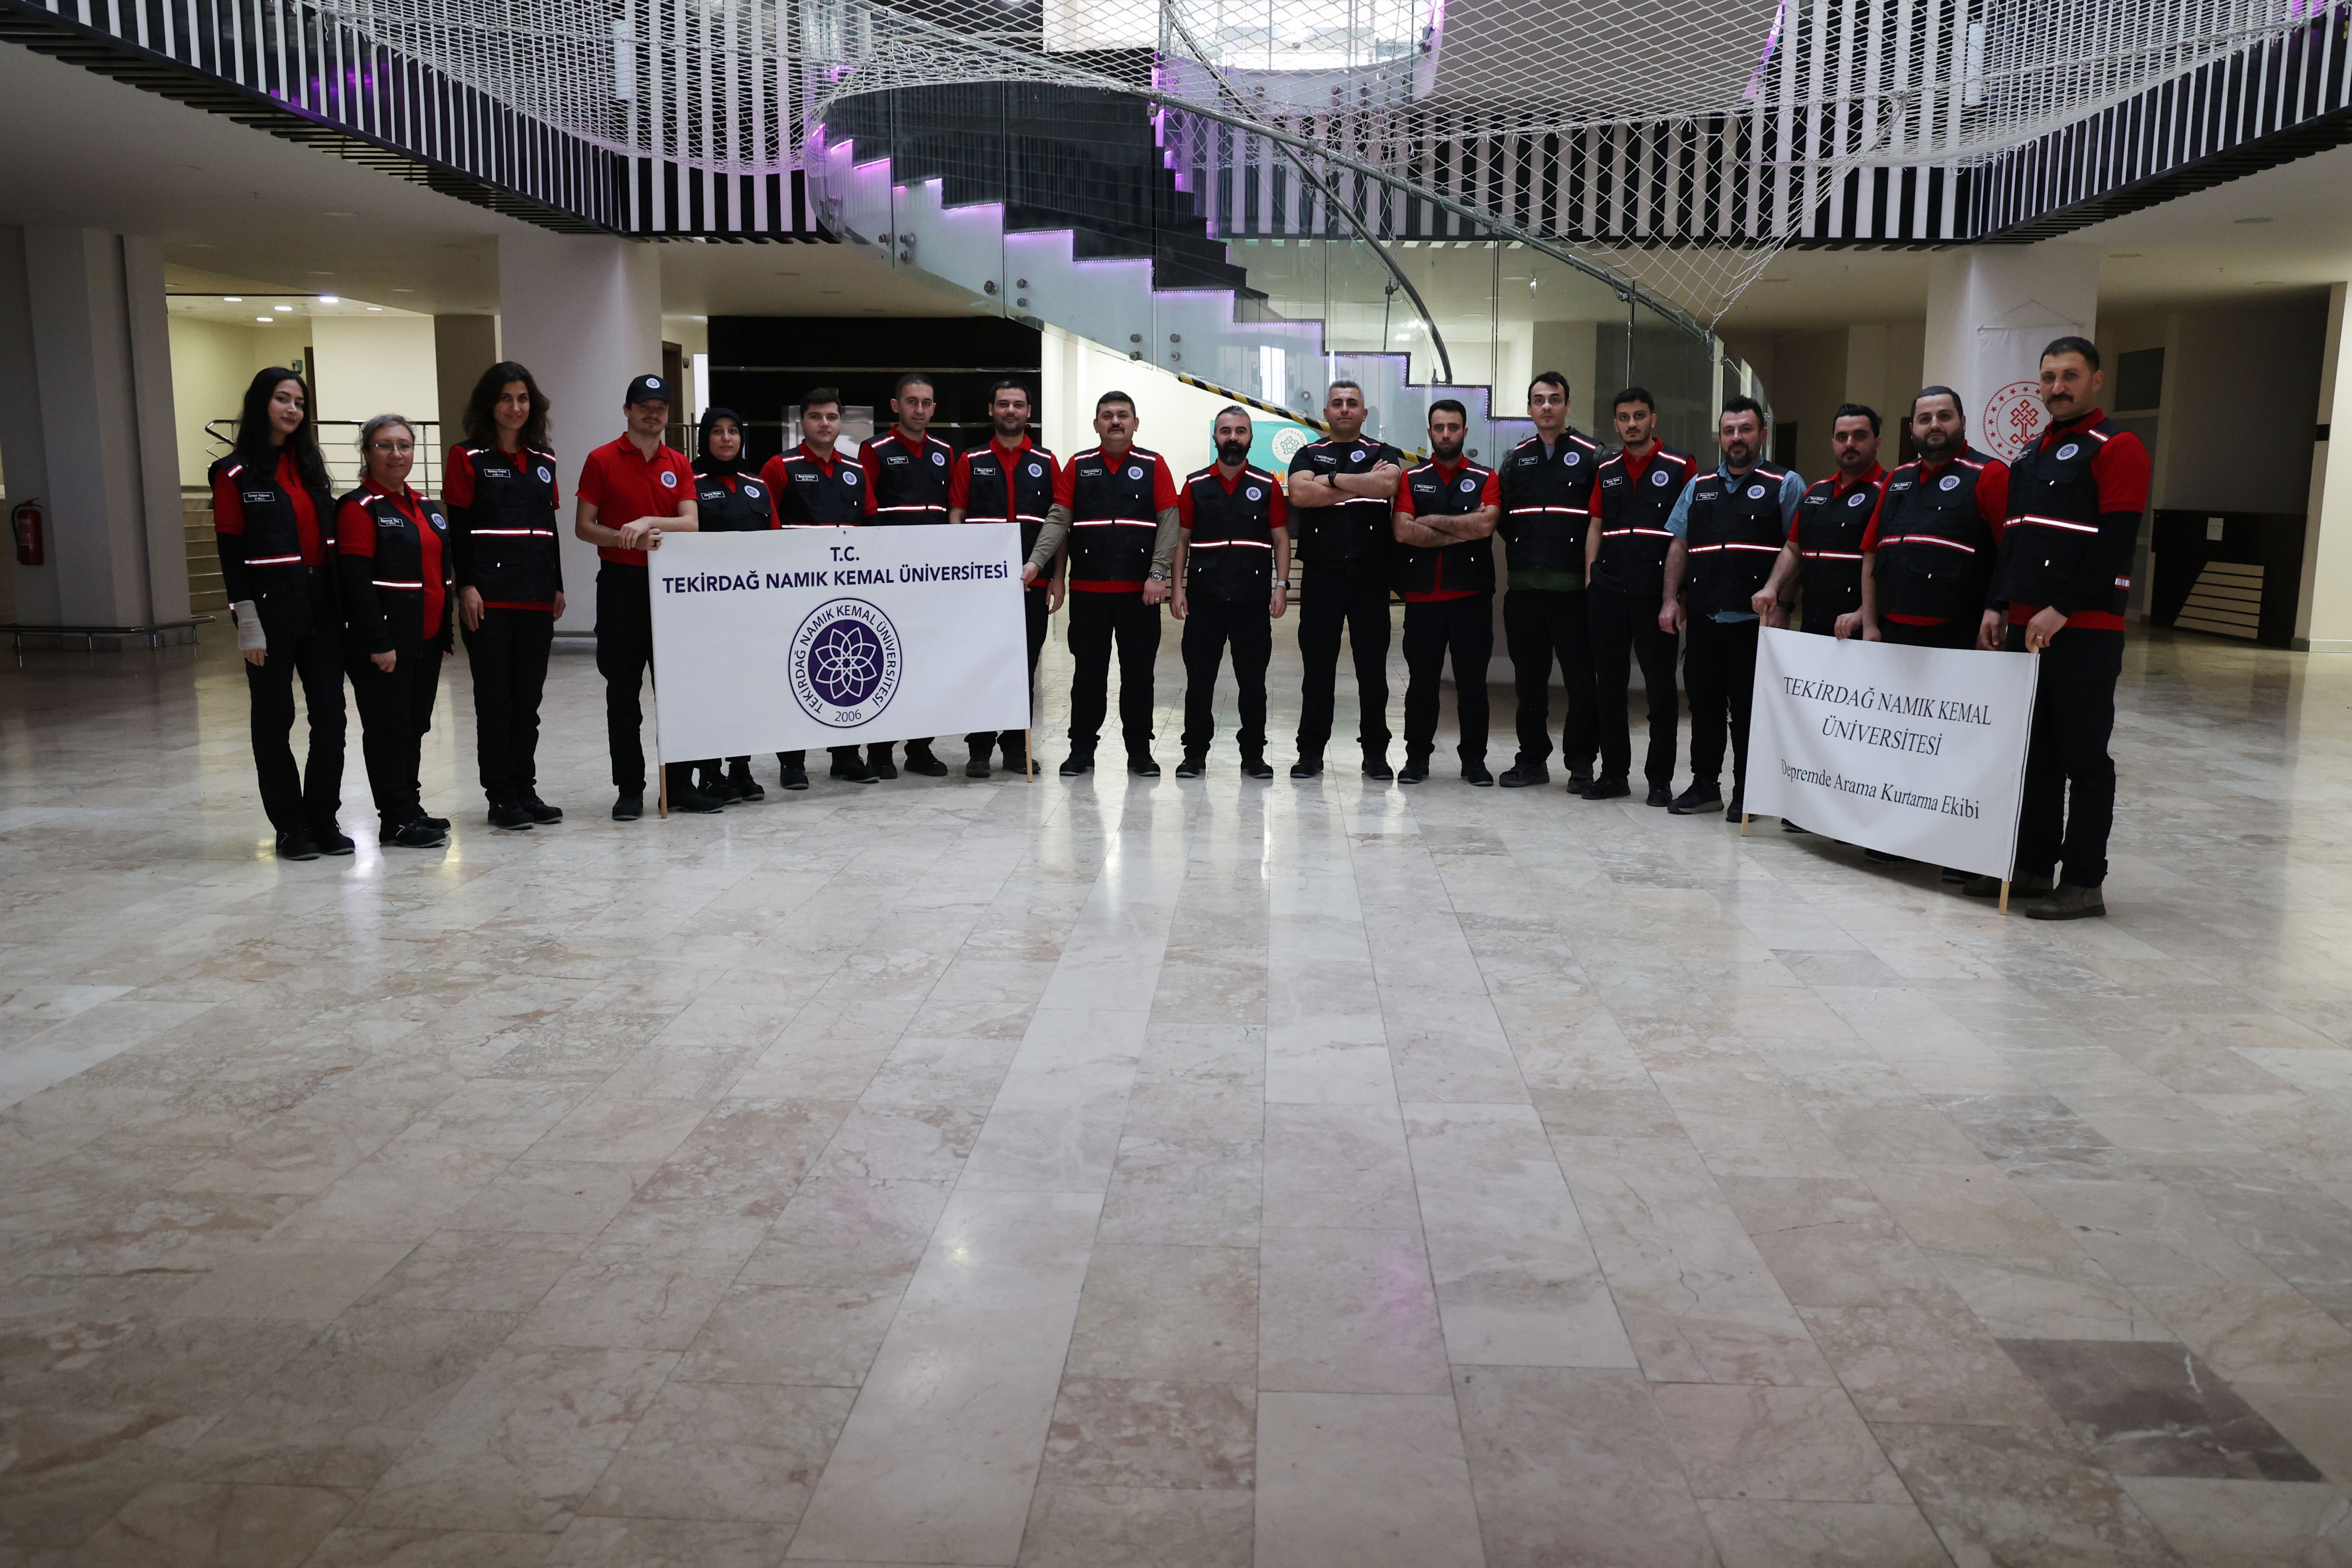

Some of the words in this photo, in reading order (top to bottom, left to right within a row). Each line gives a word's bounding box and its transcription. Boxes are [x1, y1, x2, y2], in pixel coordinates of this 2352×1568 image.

[830, 546, 860, 562] T.C.
[662, 570, 760, 594] TEKİRDAĞ
[766, 571, 828, 589] NAMIK
[834, 569, 895, 585] KEMAL
[900, 560, 1008, 583] ÜNİVERSİTESİ
[800, 608, 835, 646] NAMIK
[836, 605, 876, 626] KEMAL
[794, 649, 823, 714] TEKİRDAĞ
[872, 621, 896, 708] ÜNİVERSİTESİ
[834, 709, 862, 722] 2006
[1783, 677, 1875, 709] TEKİRDAĞ
[1877, 692, 1936, 718] NAMIK
[1937, 700, 1992, 725] KEMAL
[1822, 714, 1943, 756] ÜNİVERSİTESİ
[1781, 758, 1832, 787] Depremde
[1834, 773, 1877, 798] Arama
[1880, 783, 1938, 811] Kurtarma
[1940, 795, 1980, 819] Ekibi
